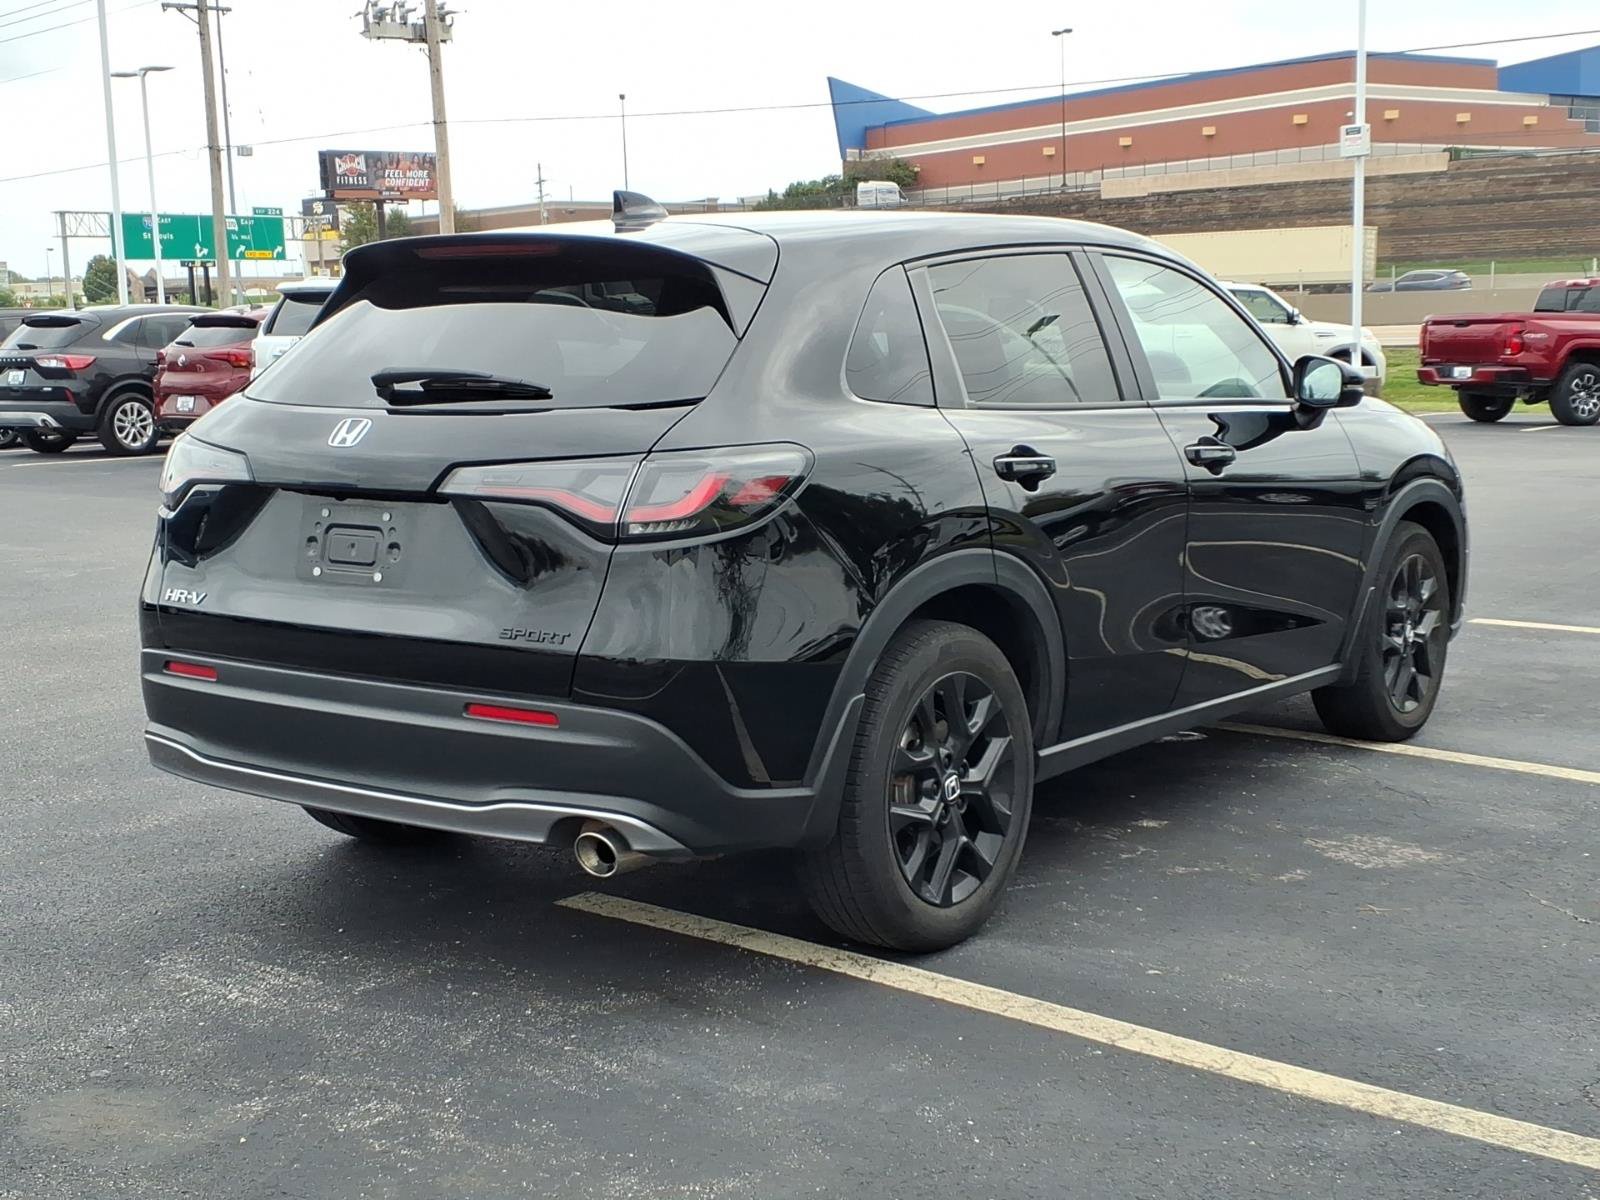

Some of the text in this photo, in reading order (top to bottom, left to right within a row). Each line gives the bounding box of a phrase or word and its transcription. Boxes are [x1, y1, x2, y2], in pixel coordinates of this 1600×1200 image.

[384, 169, 429, 178] FEEL MORE
[336, 176, 368, 185] FITNESS
[384, 178, 430, 187] CONFIDENT
[165, 588, 208, 605] HR-V
[499, 628, 572, 645] SPORT
